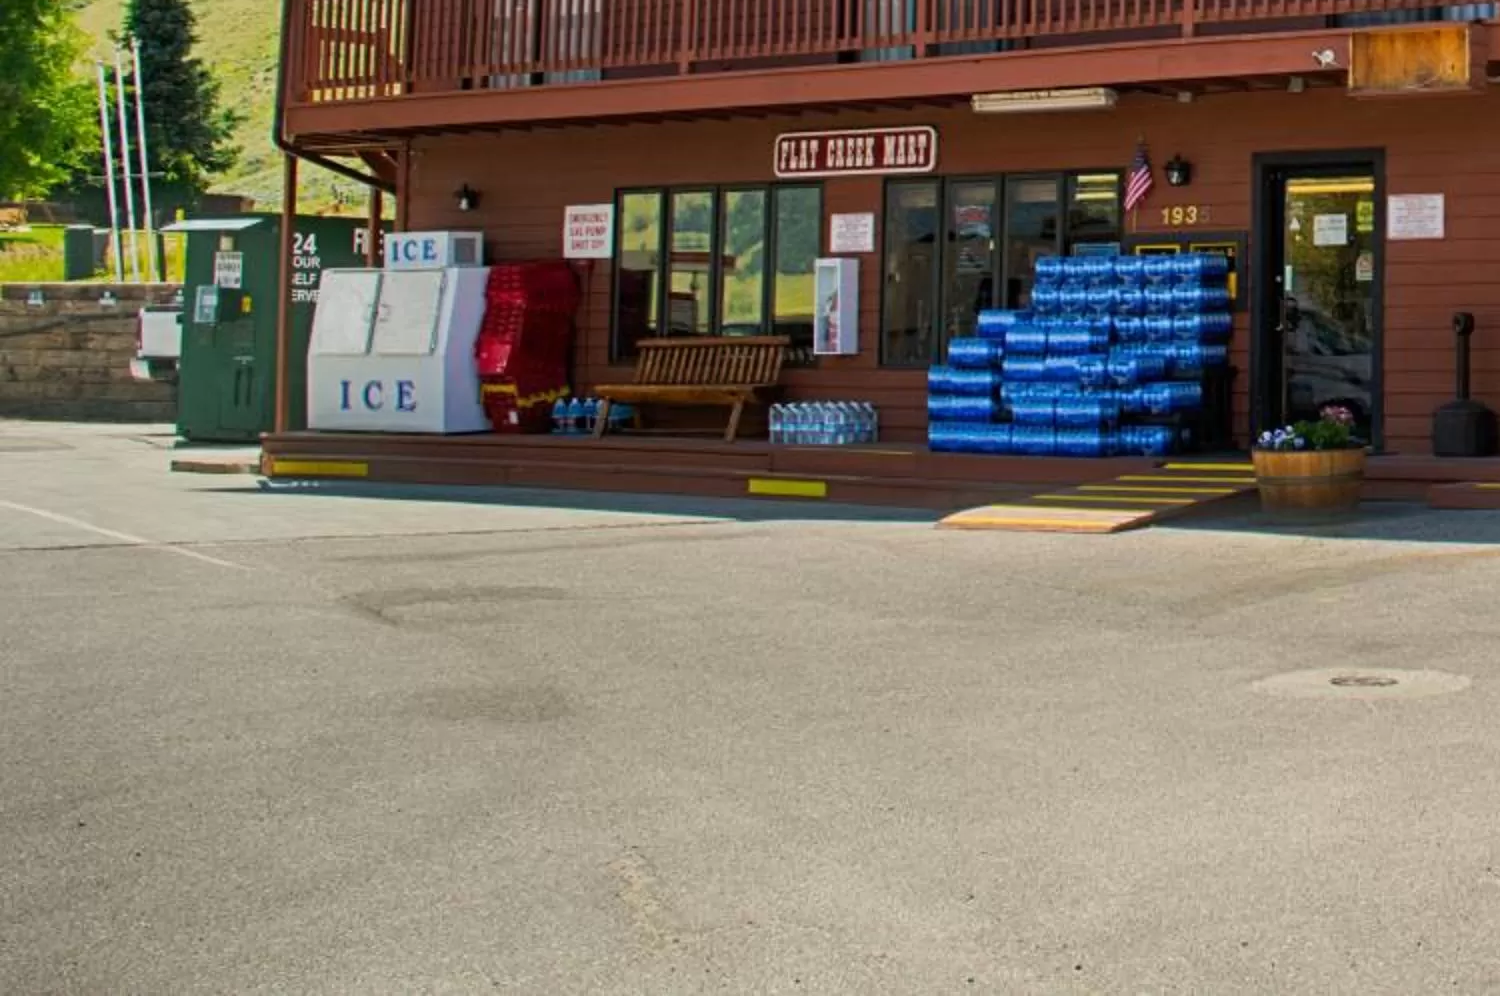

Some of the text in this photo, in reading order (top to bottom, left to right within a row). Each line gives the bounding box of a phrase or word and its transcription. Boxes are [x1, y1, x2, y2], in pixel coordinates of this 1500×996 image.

[780, 133, 928, 170] FLAT CREEK MART
[293, 232, 317, 255] 24
[391, 239, 438, 262] ICE
[292, 255, 321, 269] OUR
[291, 288, 321, 302] ERVE
[339, 378, 417, 413] ICE
